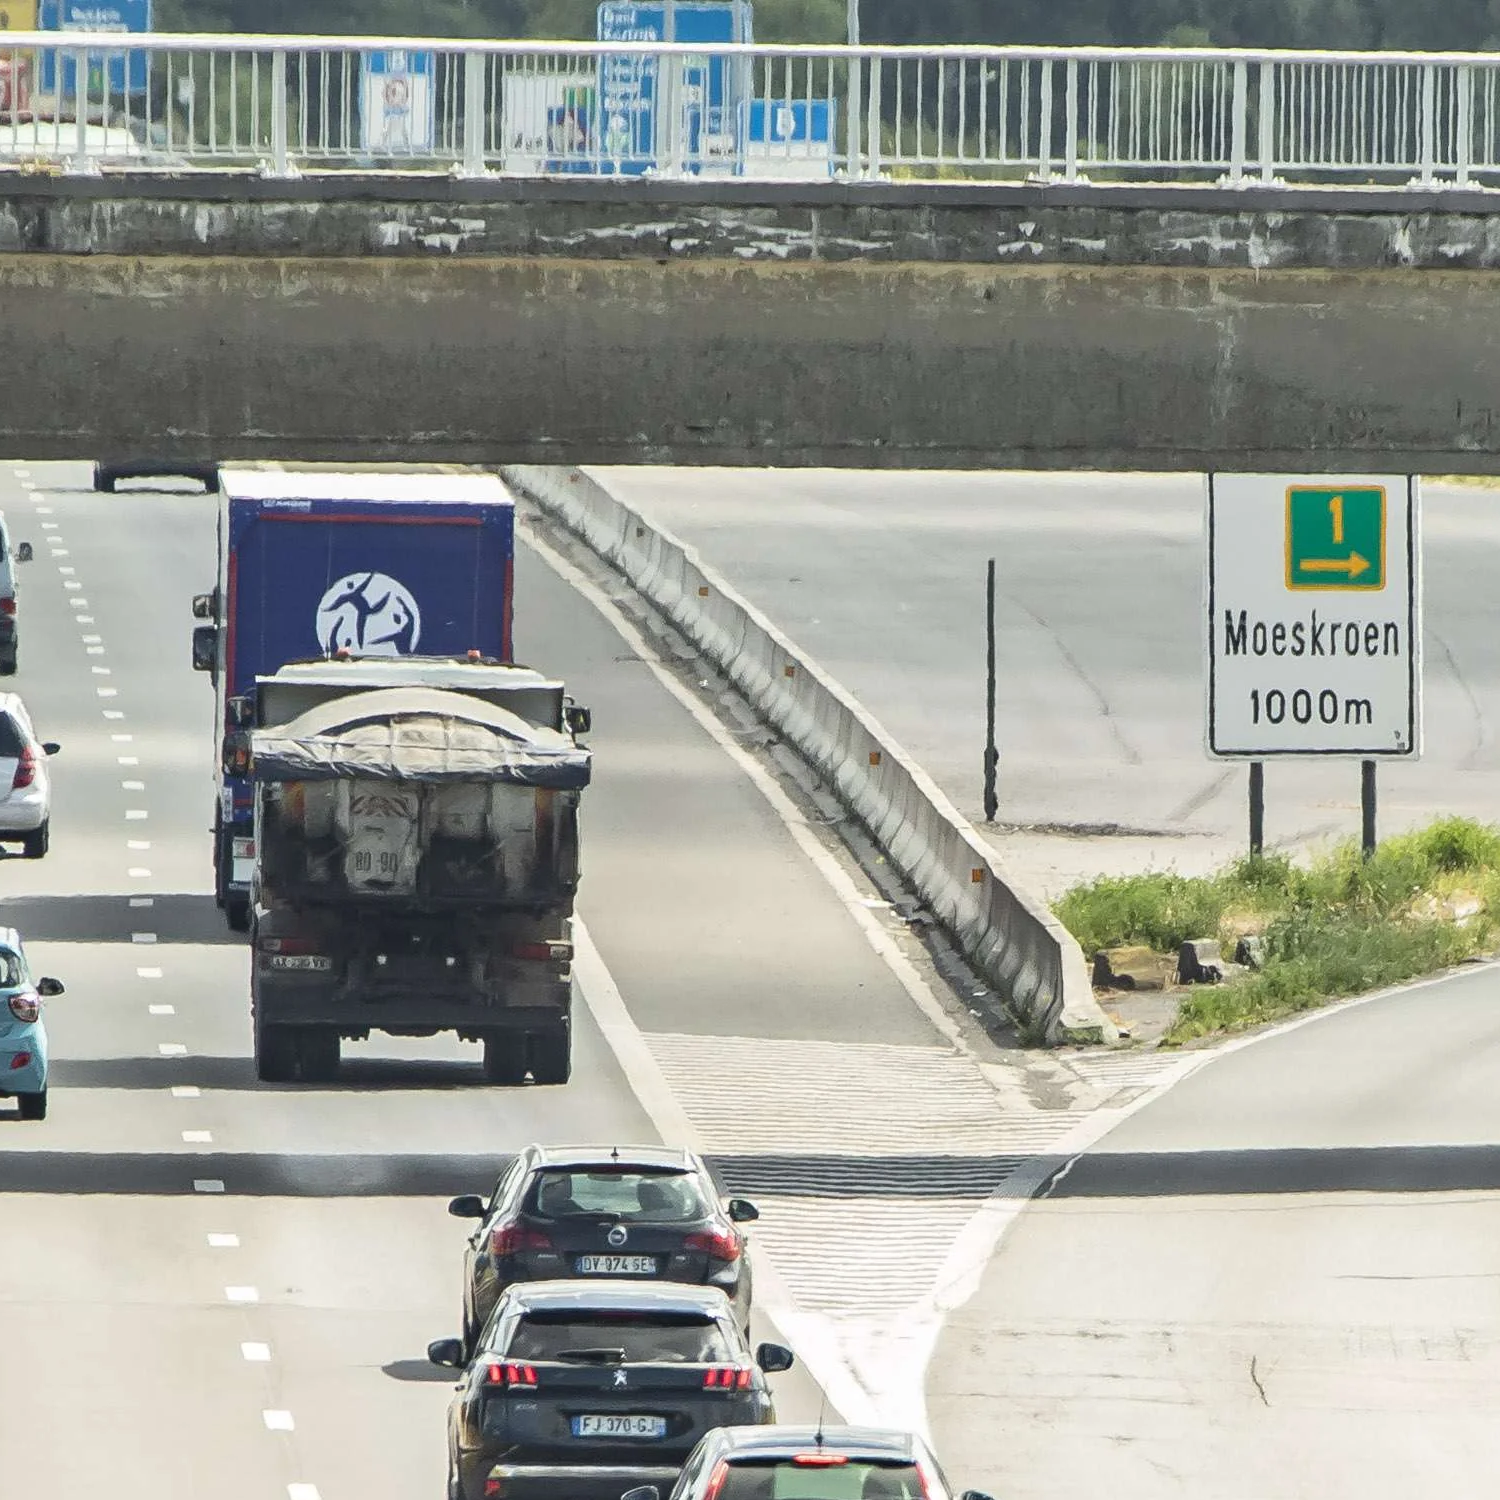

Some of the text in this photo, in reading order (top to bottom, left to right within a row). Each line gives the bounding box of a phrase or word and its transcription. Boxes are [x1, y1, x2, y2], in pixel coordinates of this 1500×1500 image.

[1328, 495, 1344, 545] 1
[1224, 609, 1399, 656] Moeskroen
[1250, 688, 1373, 724] 1000m
